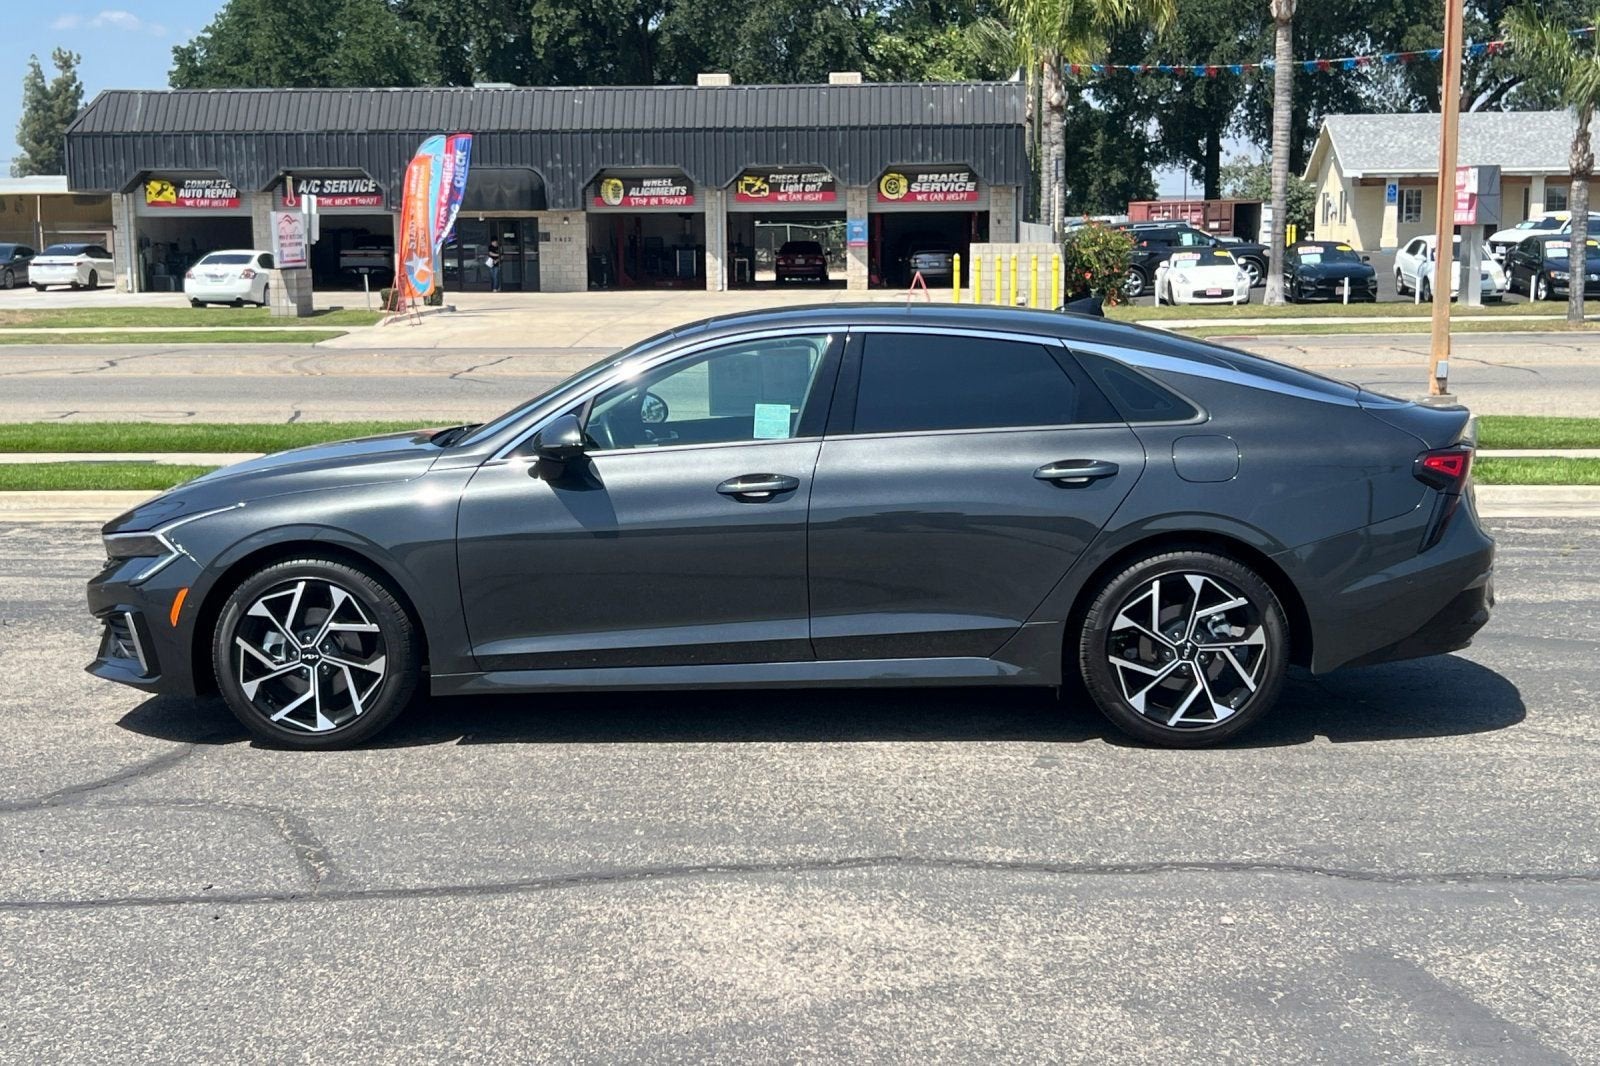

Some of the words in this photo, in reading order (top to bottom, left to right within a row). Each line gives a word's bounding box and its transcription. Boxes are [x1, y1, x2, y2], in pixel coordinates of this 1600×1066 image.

[454, 150, 467, 188] CHECK
[769, 173, 800, 183] CHECK
[801, 173, 833, 183] ENGINE
[917, 172, 969, 182] BRAKE
[184, 180, 231, 189] COMPLETE
[298, 179, 321, 194] A/C
[323, 179, 377, 193] SERVICE
[642, 178, 673, 187] WHEEL
[910, 182, 976, 192] SERVICE
[179, 188, 202, 198] AUTO
[204, 188, 237, 198] REPAIR
[628, 186, 687, 196] ALIGNMENTS
[779, 182, 803, 194] Light
[804, 182, 823, 192] on?
[318, 197, 333, 206] THE
[335, 197, 352, 206] HEAT
[630, 197, 648, 206] STOP
[929, 193, 945, 201] CAN
[946, 192, 968, 201] HELP!
[184, 199, 195, 207] WE
[196, 199, 209, 207] CAN
